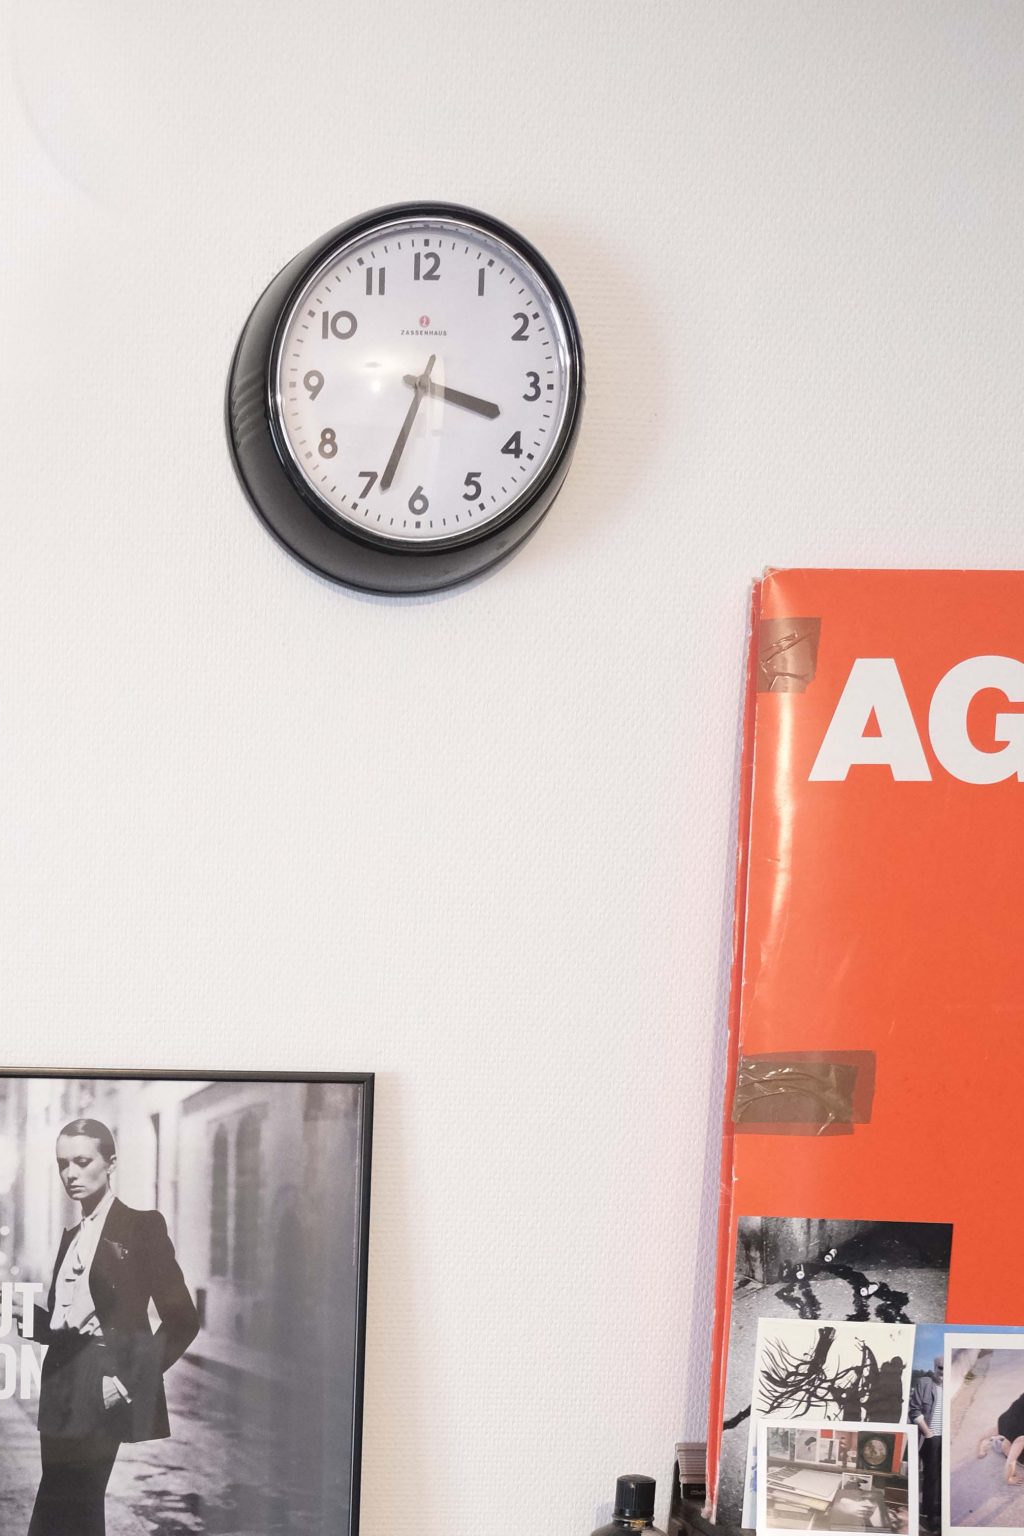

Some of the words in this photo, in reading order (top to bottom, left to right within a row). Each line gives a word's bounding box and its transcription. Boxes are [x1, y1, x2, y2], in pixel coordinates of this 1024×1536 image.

[414, 252, 441, 280] 12
[366, 267, 386, 295] 11
[478, 268, 485, 296] 1
[322, 310, 358, 340] 10
[400, 329, 448, 337] ZASSENHAUS
[511, 312, 530, 341] 2
[303, 369, 325, 400] 9
[523, 372, 541, 402] 3
[318, 428, 338, 459] 8
[501, 431, 523, 459] 4
[358, 471, 378, 499] 7
[462, 472, 481, 501] 5
[408, 485, 430, 515] 6
